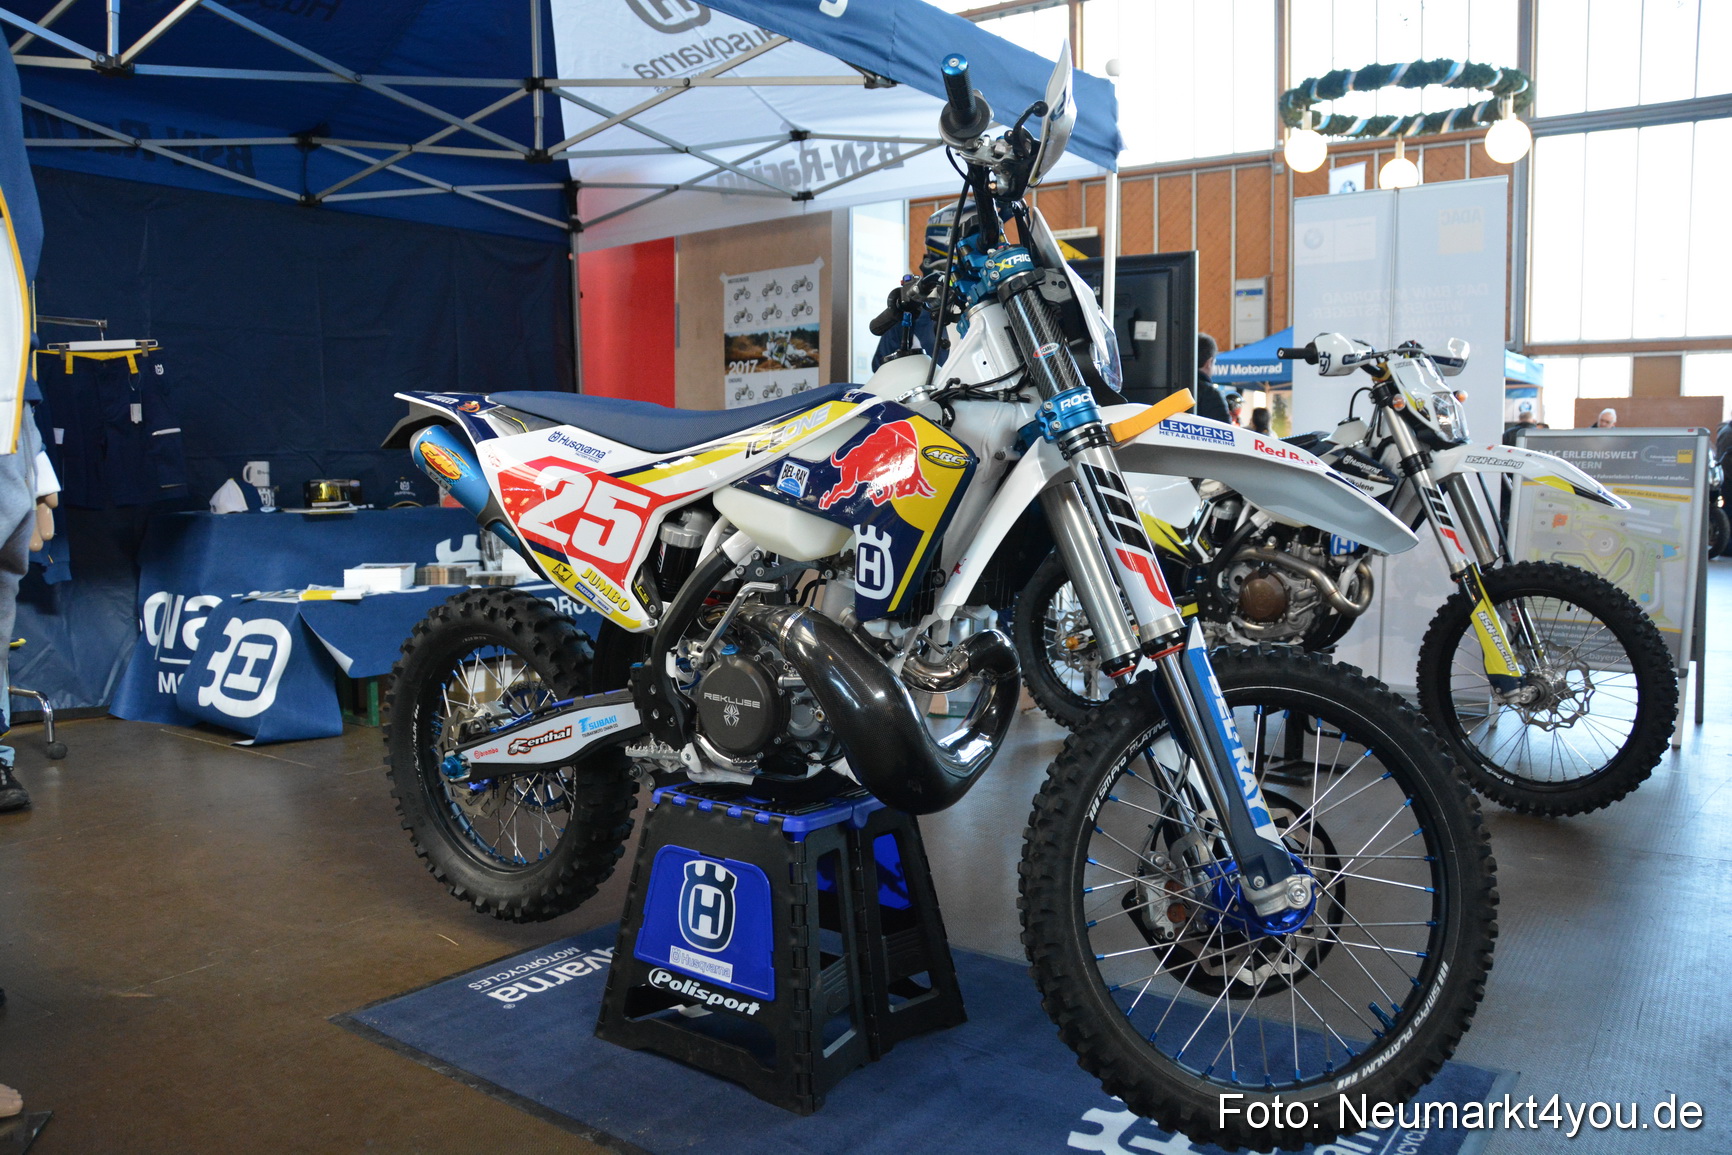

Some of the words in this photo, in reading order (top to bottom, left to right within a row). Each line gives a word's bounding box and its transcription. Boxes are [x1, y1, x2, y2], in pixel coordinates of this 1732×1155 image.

[729, 360, 758, 376] 2017
[1212, 364, 1229, 376] MW
[1230, 362, 1283, 375] Motorrad
[1159, 430, 1236, 447] METAALBEWERKING
[1160, 421, 1234, 441] LEMMENS
[558, 434, 607, 459] Husqvarna
[1254, 439, 1286, 458] Red
[1562, 449, 1639, 461] ERLEBNISWELT
[1348, 456, 1383, 474] Husqvarna
[1465, 455, 1525, 470] BSN-Racing
[517, 464, 651, 566] 25
[581, 567, 631, 612] JUMBO
[1476, 610, 1518, 672] BSN-Racing
[703, 692, 761, 709] REKLUSE
[578, 715, 618, 734] TSUBAKI
[508, 725, 573, 756] Renthal
[480, 747, 499, 758] brembo
[468, 946, 581, 991] MOTORCYCLES
[681, 952, 731, 978] Husqvarna
[653, 970, 761, 1016] Polisport
[1361, 1027, 1414, 1078] PLATINUM
